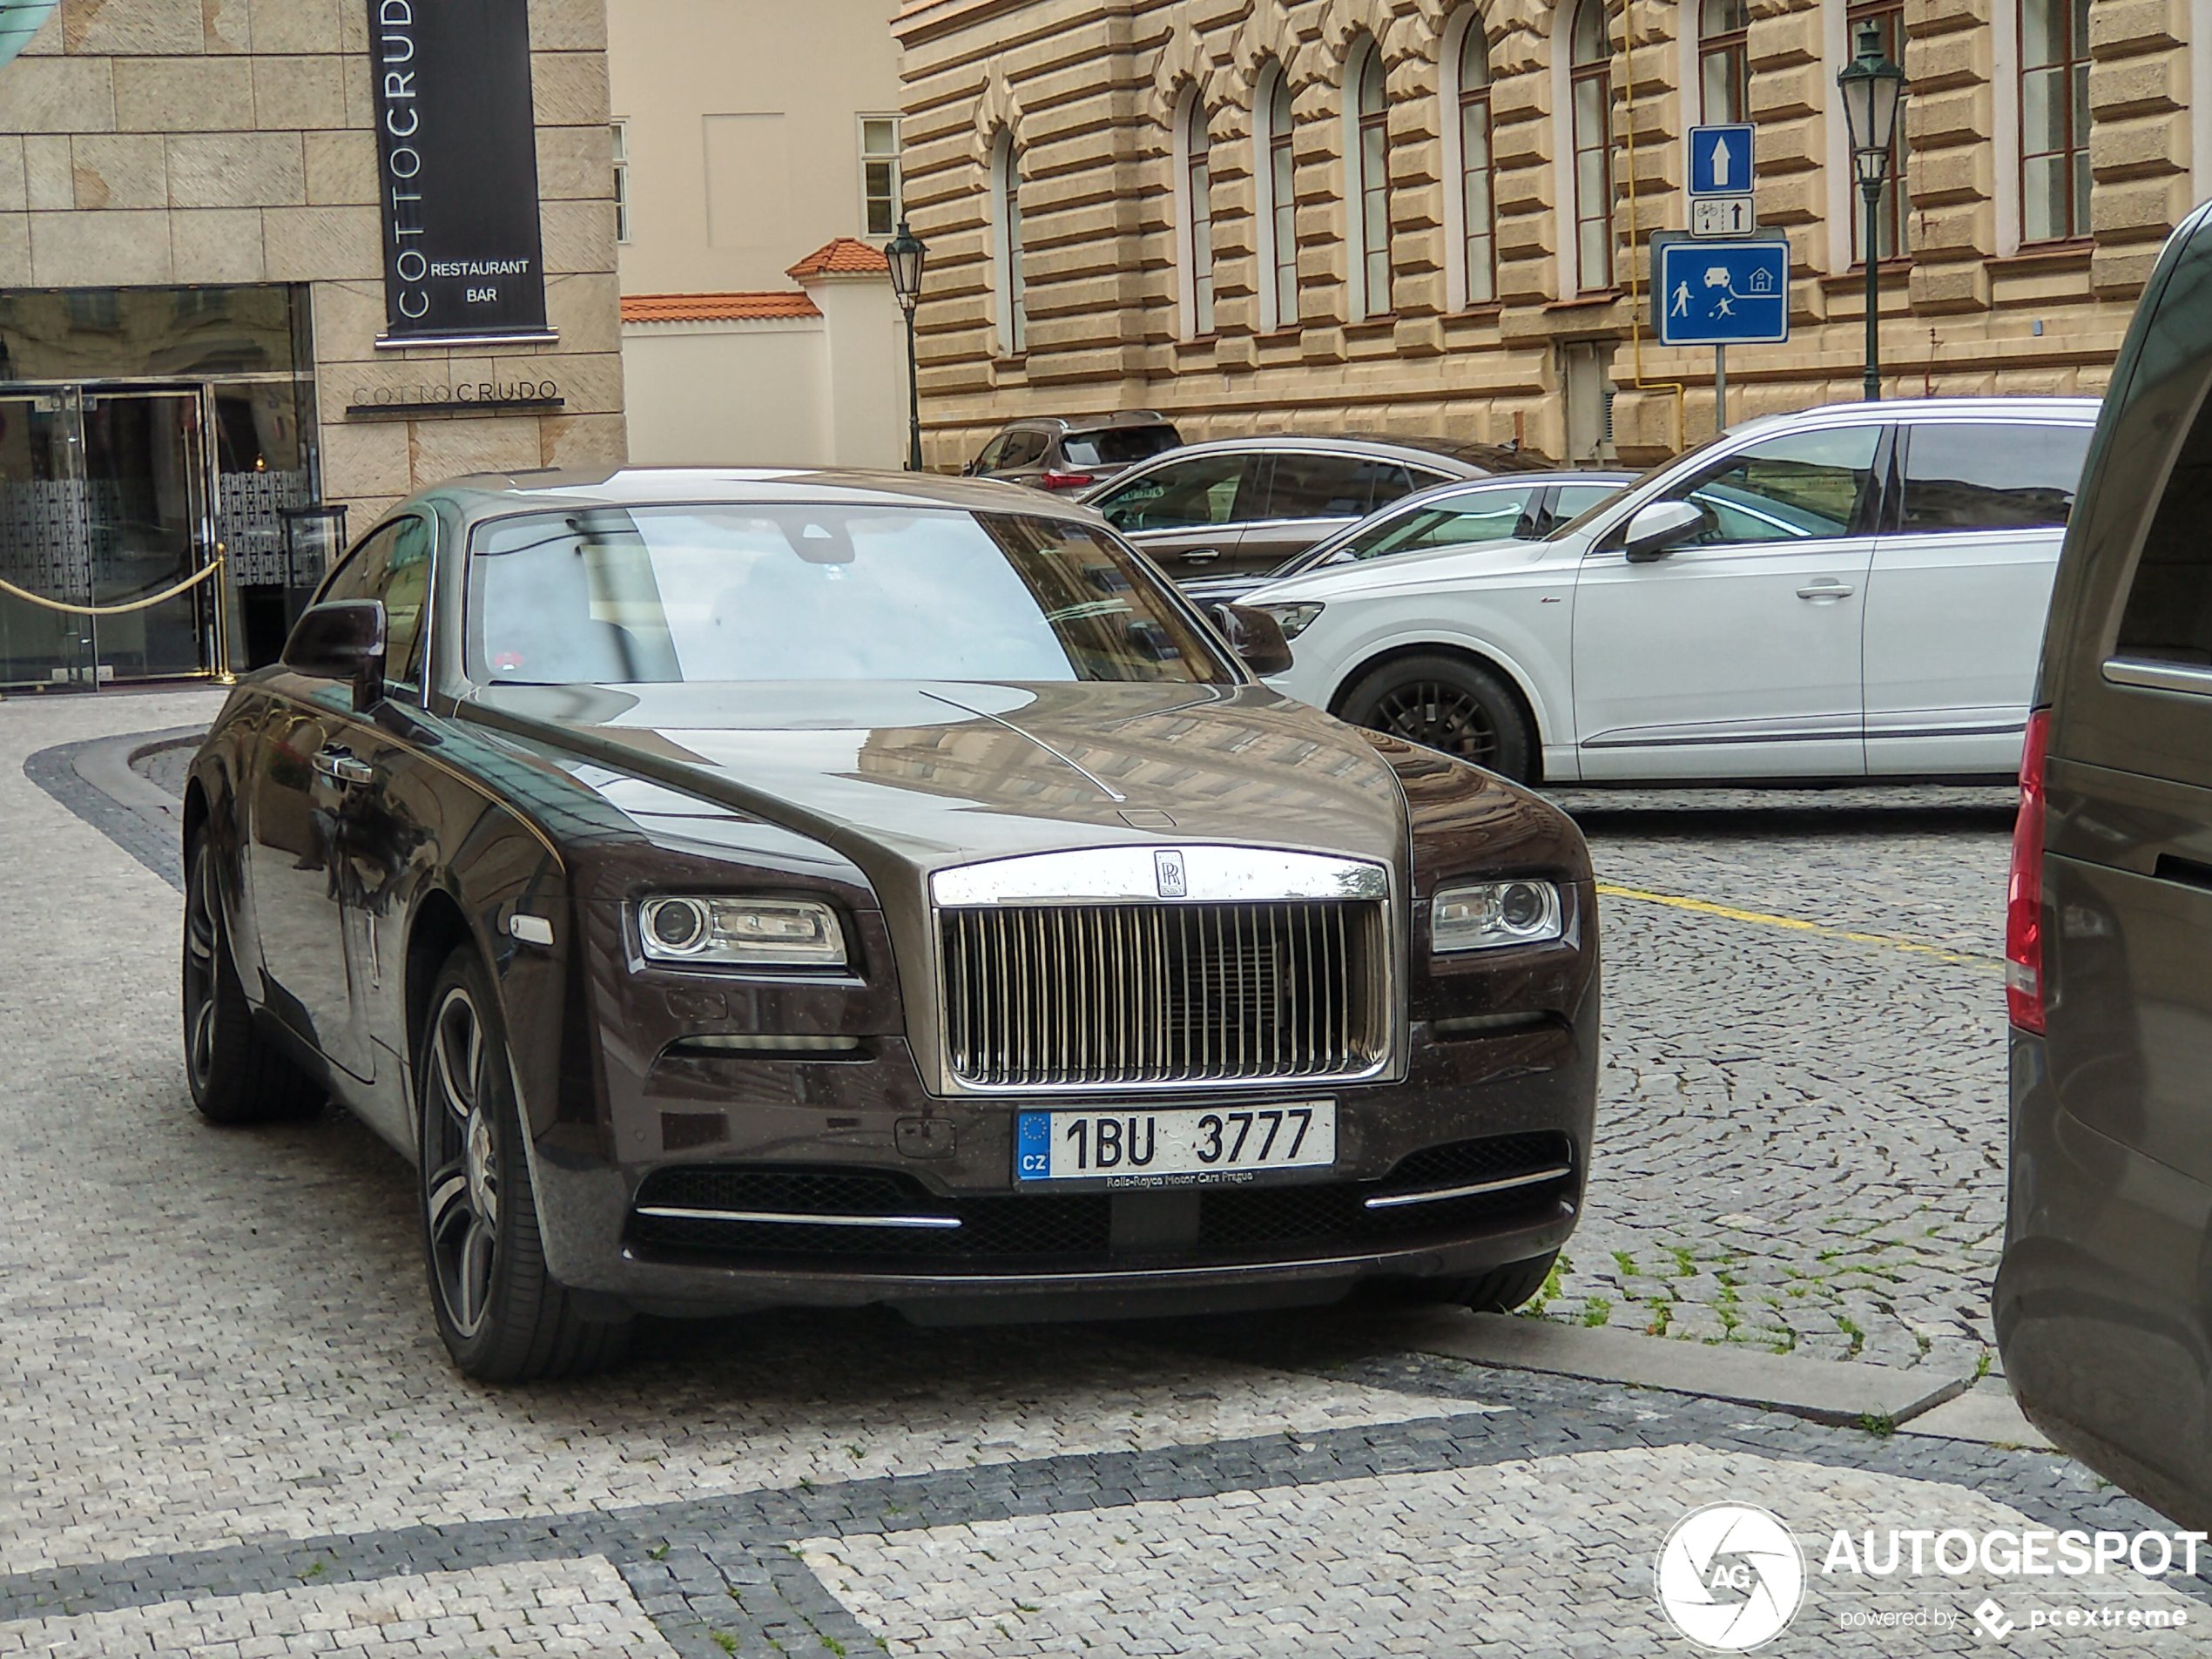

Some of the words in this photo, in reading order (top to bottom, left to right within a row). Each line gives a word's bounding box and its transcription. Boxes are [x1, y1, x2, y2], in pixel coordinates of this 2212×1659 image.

[431, 260, 529, 276] RESTAURANT
[467, 288, 496, 302] BAR
[1067, 1116, 1156, 1170] 1BU
[1197, 1109, 1313, 1163] 3777
[1022, 1155, 1047, 1171] CZ
